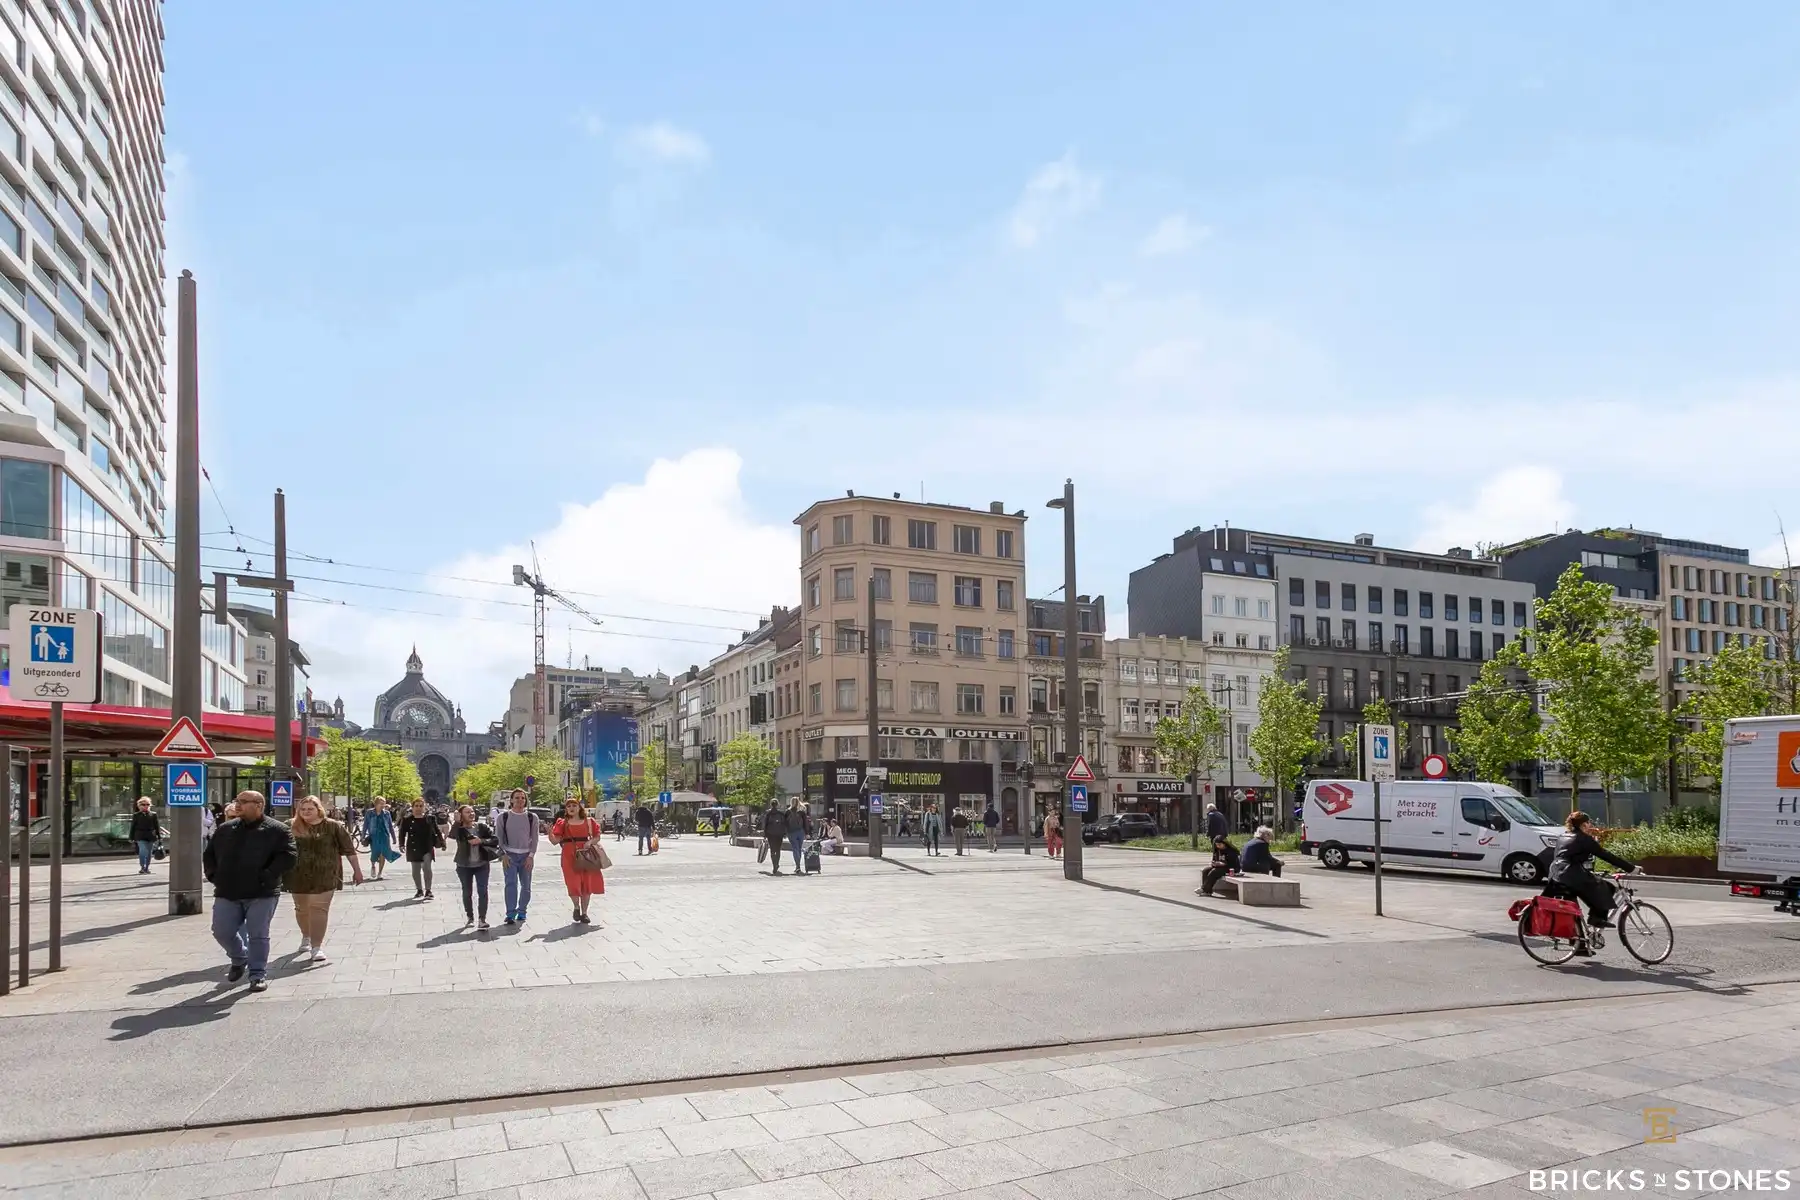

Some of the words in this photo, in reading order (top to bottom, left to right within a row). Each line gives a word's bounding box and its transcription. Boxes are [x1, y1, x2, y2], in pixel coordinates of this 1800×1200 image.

[29, 610, 77, 624] ZONE
[23, 667, 81, 678] Uitgezonderd
[804, 728, 823, 738] OUTLET
[955, 729, 1018, 739] OUTLET
[1372, 727, 1388, 735] ZONE
[838, 775, 855, 783] OUTLET
[888, 772, 909, 785] TOTALE
[909, 772, 942, 785] UITVERKOOP
[1142, 782, 1183, 791] DAMART
[172, 794, 201, 802] TRAM
[1398, 799, 1415, 807] Met
[1417, 800, 1437, 810] zorg
[1396, 809, 1438, 818] gebracht.
